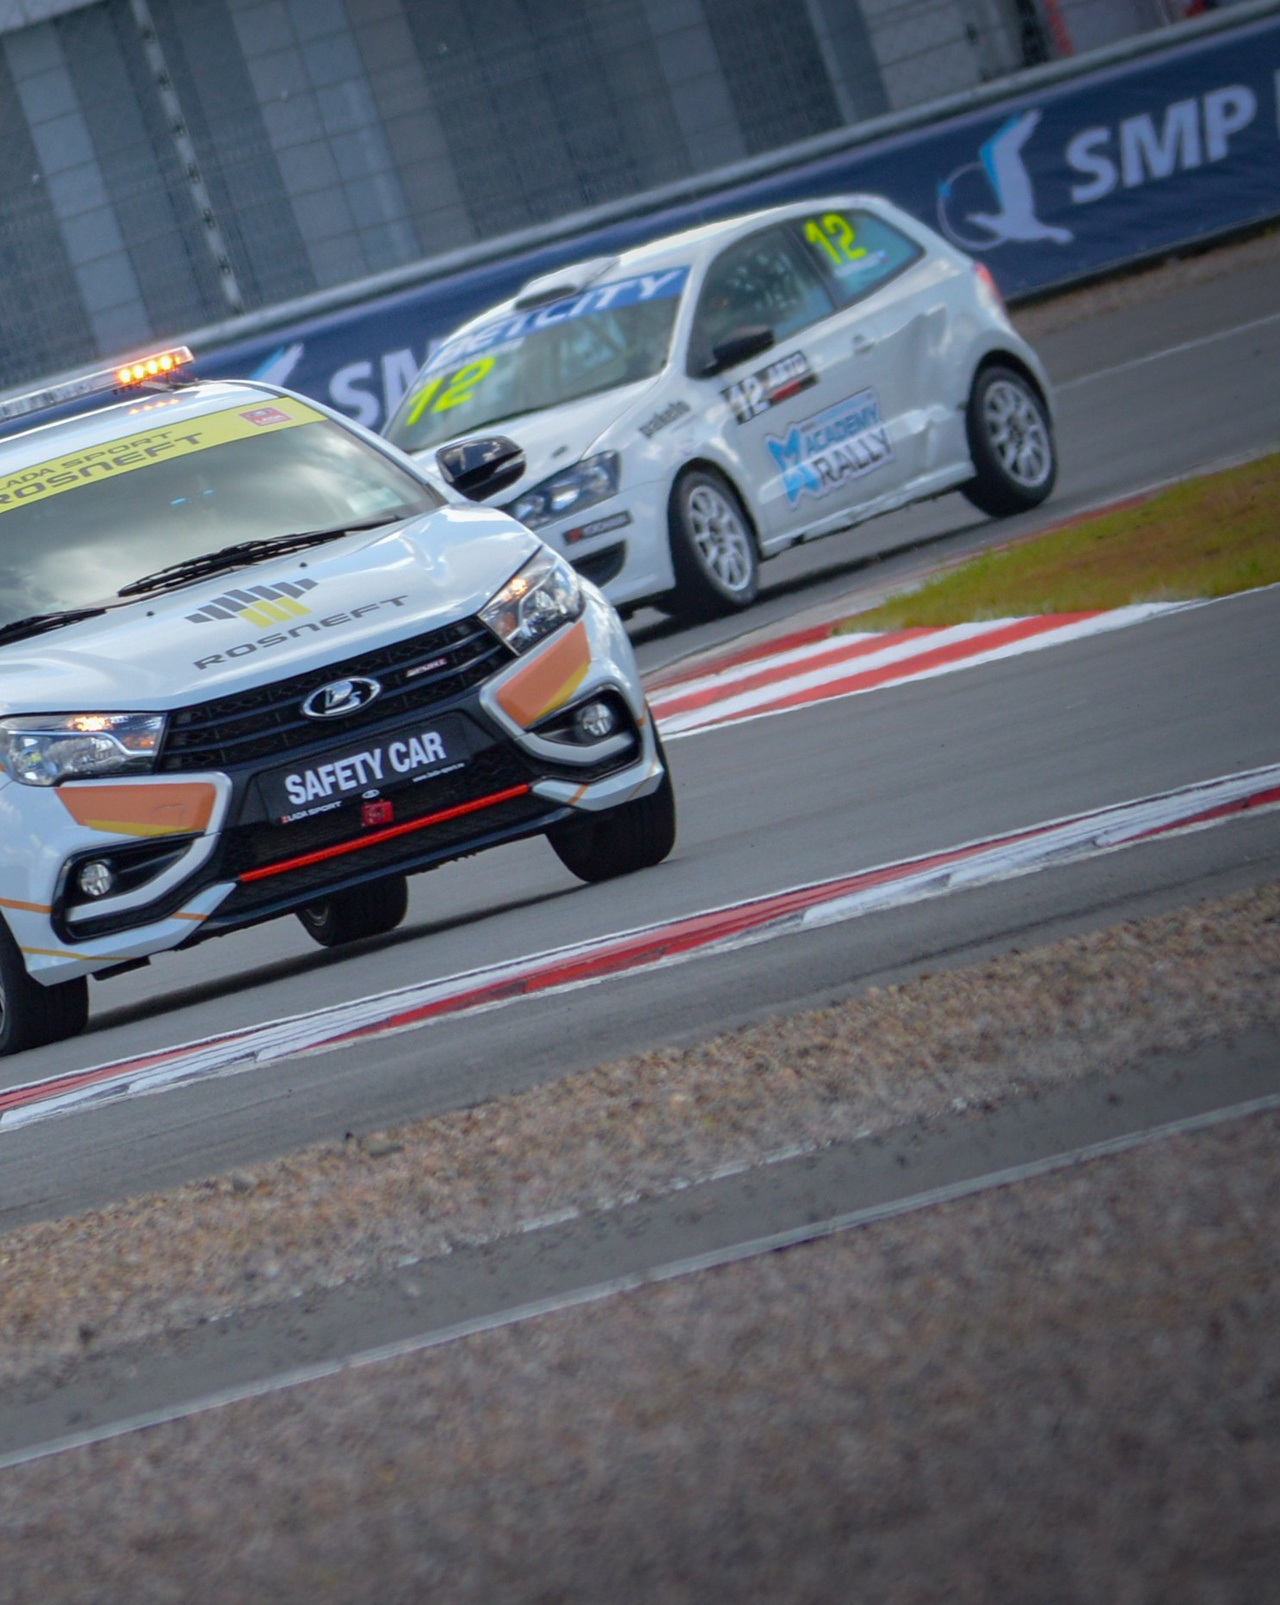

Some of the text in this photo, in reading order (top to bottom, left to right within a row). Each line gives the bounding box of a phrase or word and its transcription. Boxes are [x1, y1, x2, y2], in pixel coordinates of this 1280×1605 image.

[1066, 84, 1259, 205] SMP
[803, 213, 867, 266] 12
[406, 356, 496, 427] 12
[60, 432, 175, 470] SPORT
[805, 402, 879, 455] ACADEMY
[811, 428, 891, 486] RALLY
[193, 595, 410, 671] ROSNEFT
[284, 731, 448, 806] SAFETY CAR
